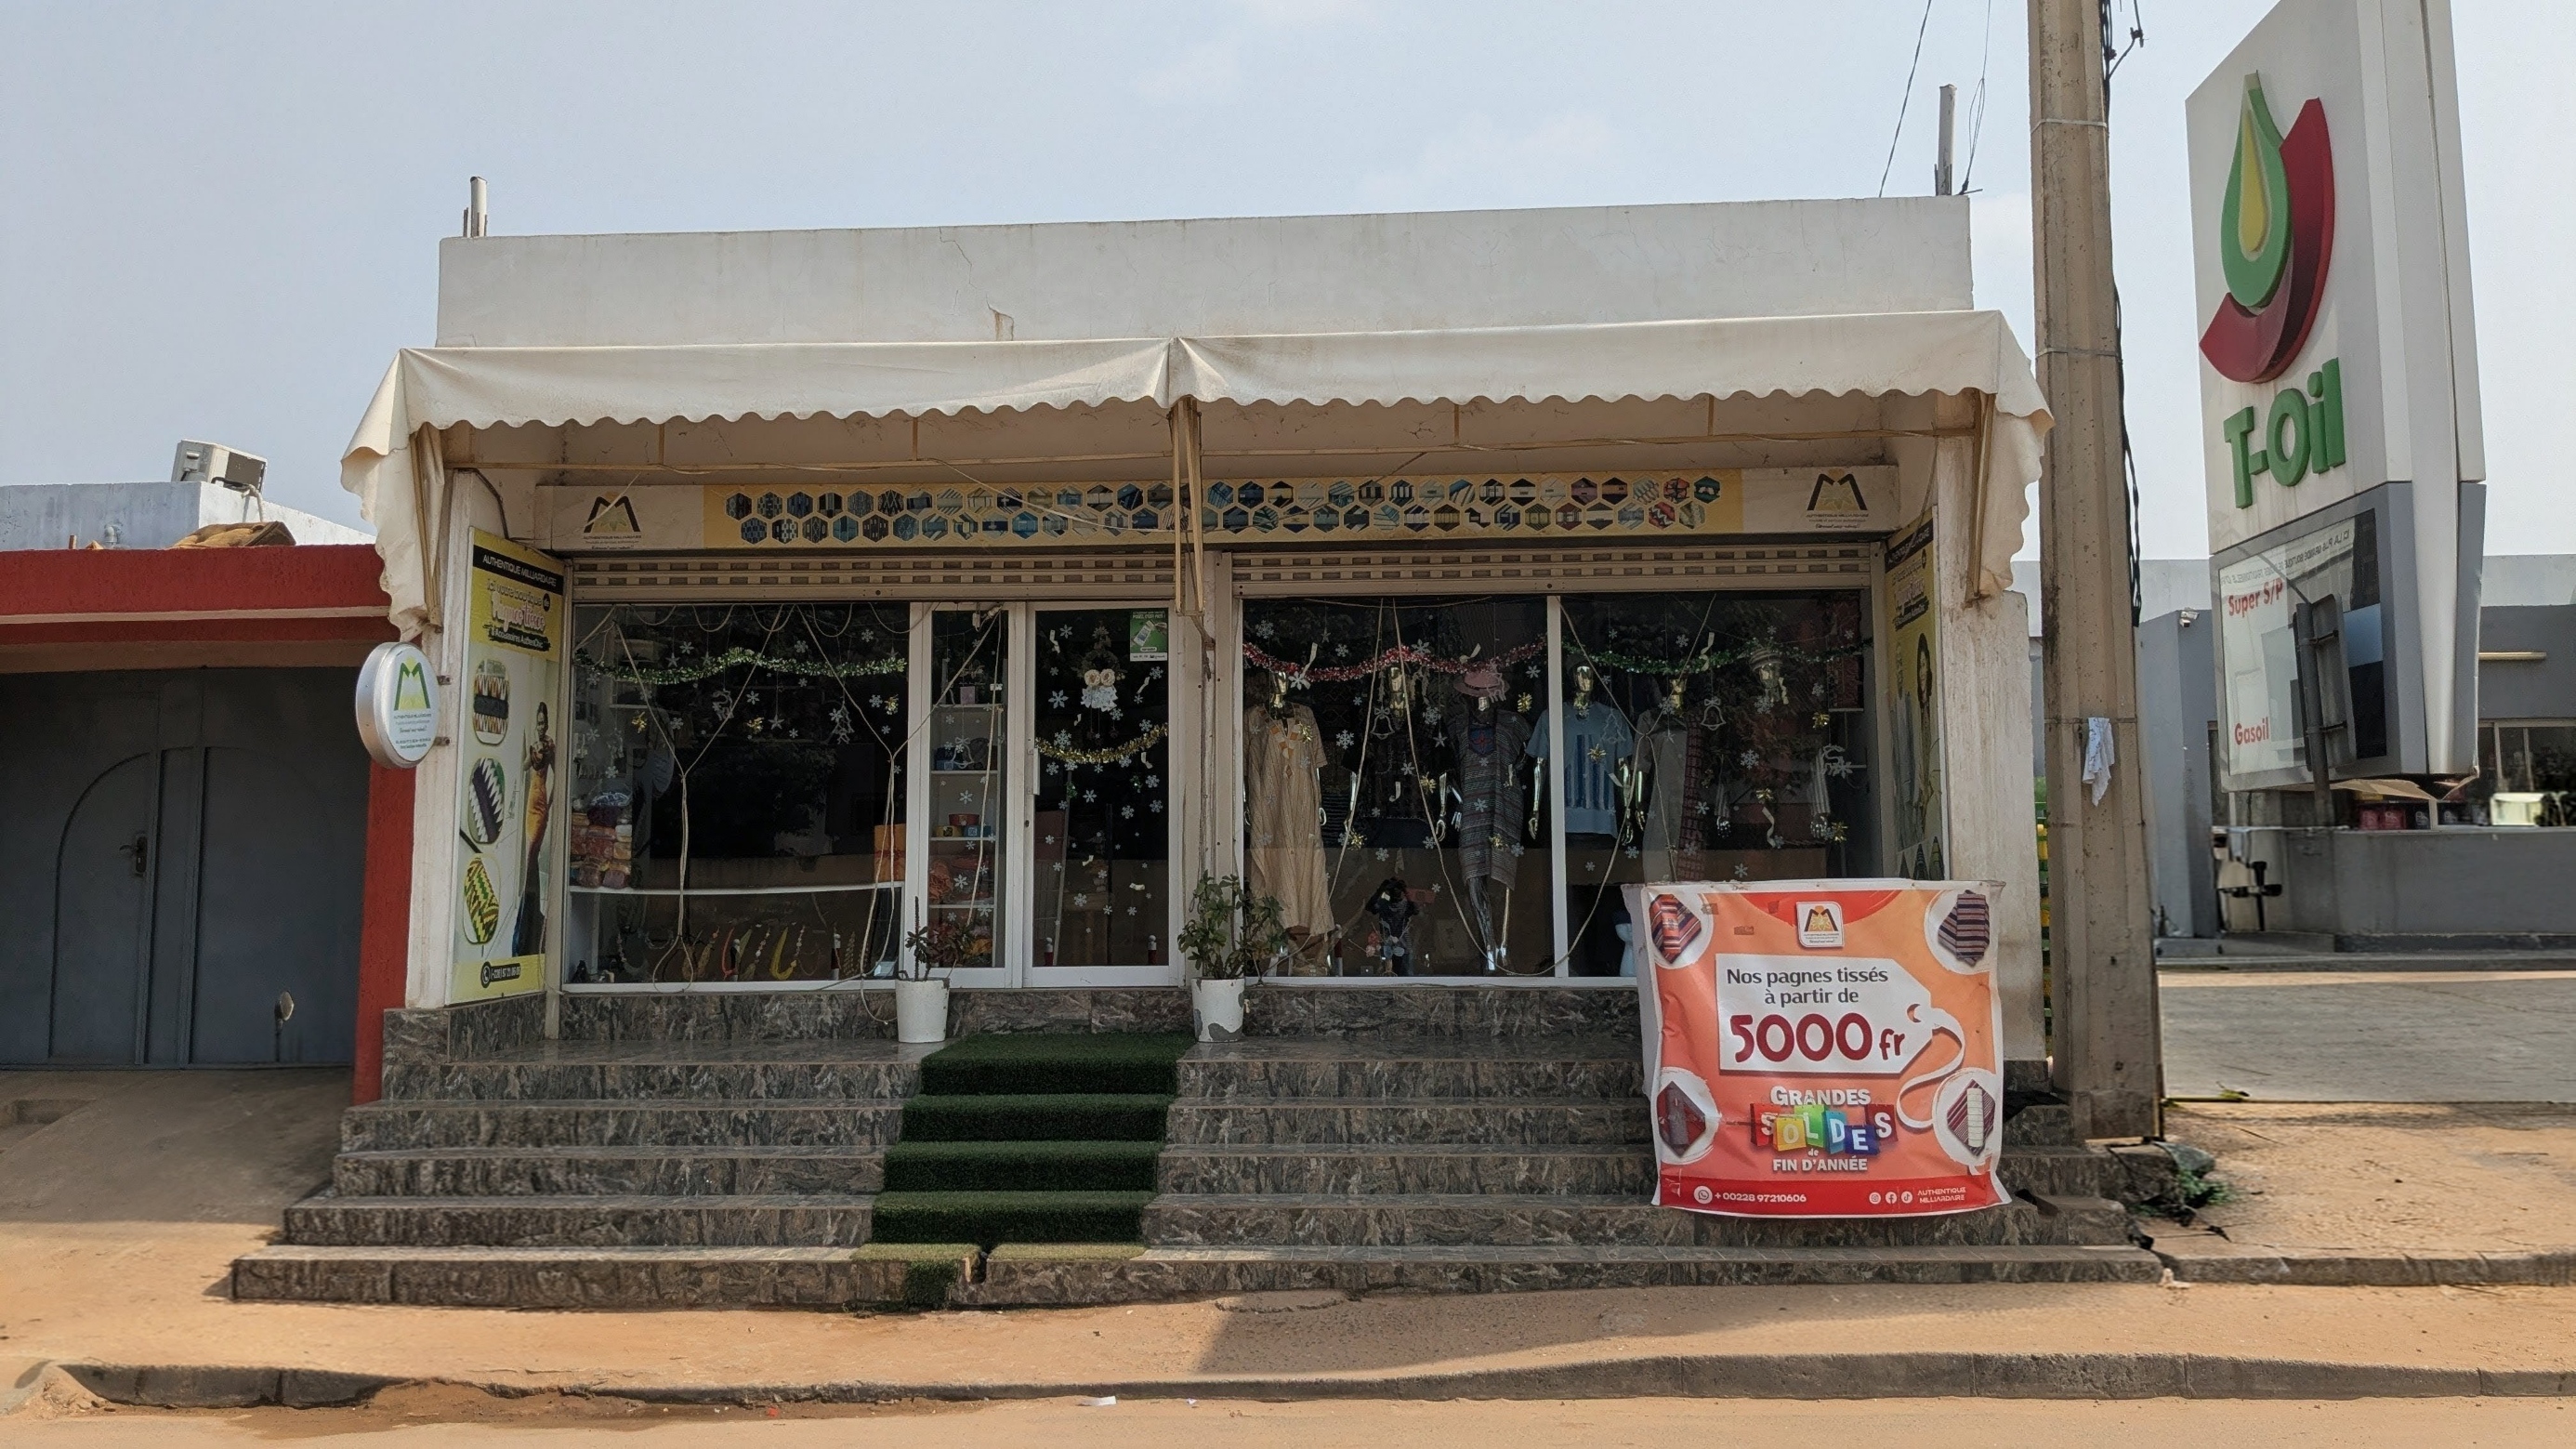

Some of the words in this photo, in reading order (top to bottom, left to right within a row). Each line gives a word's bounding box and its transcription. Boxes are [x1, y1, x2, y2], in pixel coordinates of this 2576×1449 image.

[2223, 357, 2346, 509] T-Oil
[482, 554, 521, 575] AUTHENTIQUE
[2228, 591, 2261, 618] Super
[2263, 577, 2283, 605] S/P
[2234, 716, 2269, 744] Gasoil
[1727, 968, 1762, 984] Nos
[1767, 970, 1833, 988] pagnes
[1837, 967, 1889, 982] tissés
[1765, 989, 1776, 1005] à
[1780, 988, 1833, 1008] partir
[1837, 987, 1860, 1004] de
[1729, 1012, 1873, 1063] 5000
[1879, 1028, 1906, 1060] fr
[1769, 1086, 1873, 1107] GRANDES
[1760, 1112, 1893, 1152] SOLDES
[1807, 1148, 1820, 1157] de
[1773, 1158, 1797, 1172] FIN
[1801, 1155, 1868, 1172] D'ANNÉE
[1722, 1192, 1755, 1202] 00228
[1756, 1193, 1807, 1204] 97210606
[1917, 1186, 1966, 1196] AUTHENTIQUE
[1919, 1194, 1965, 1204] MILLIARDAIRE
